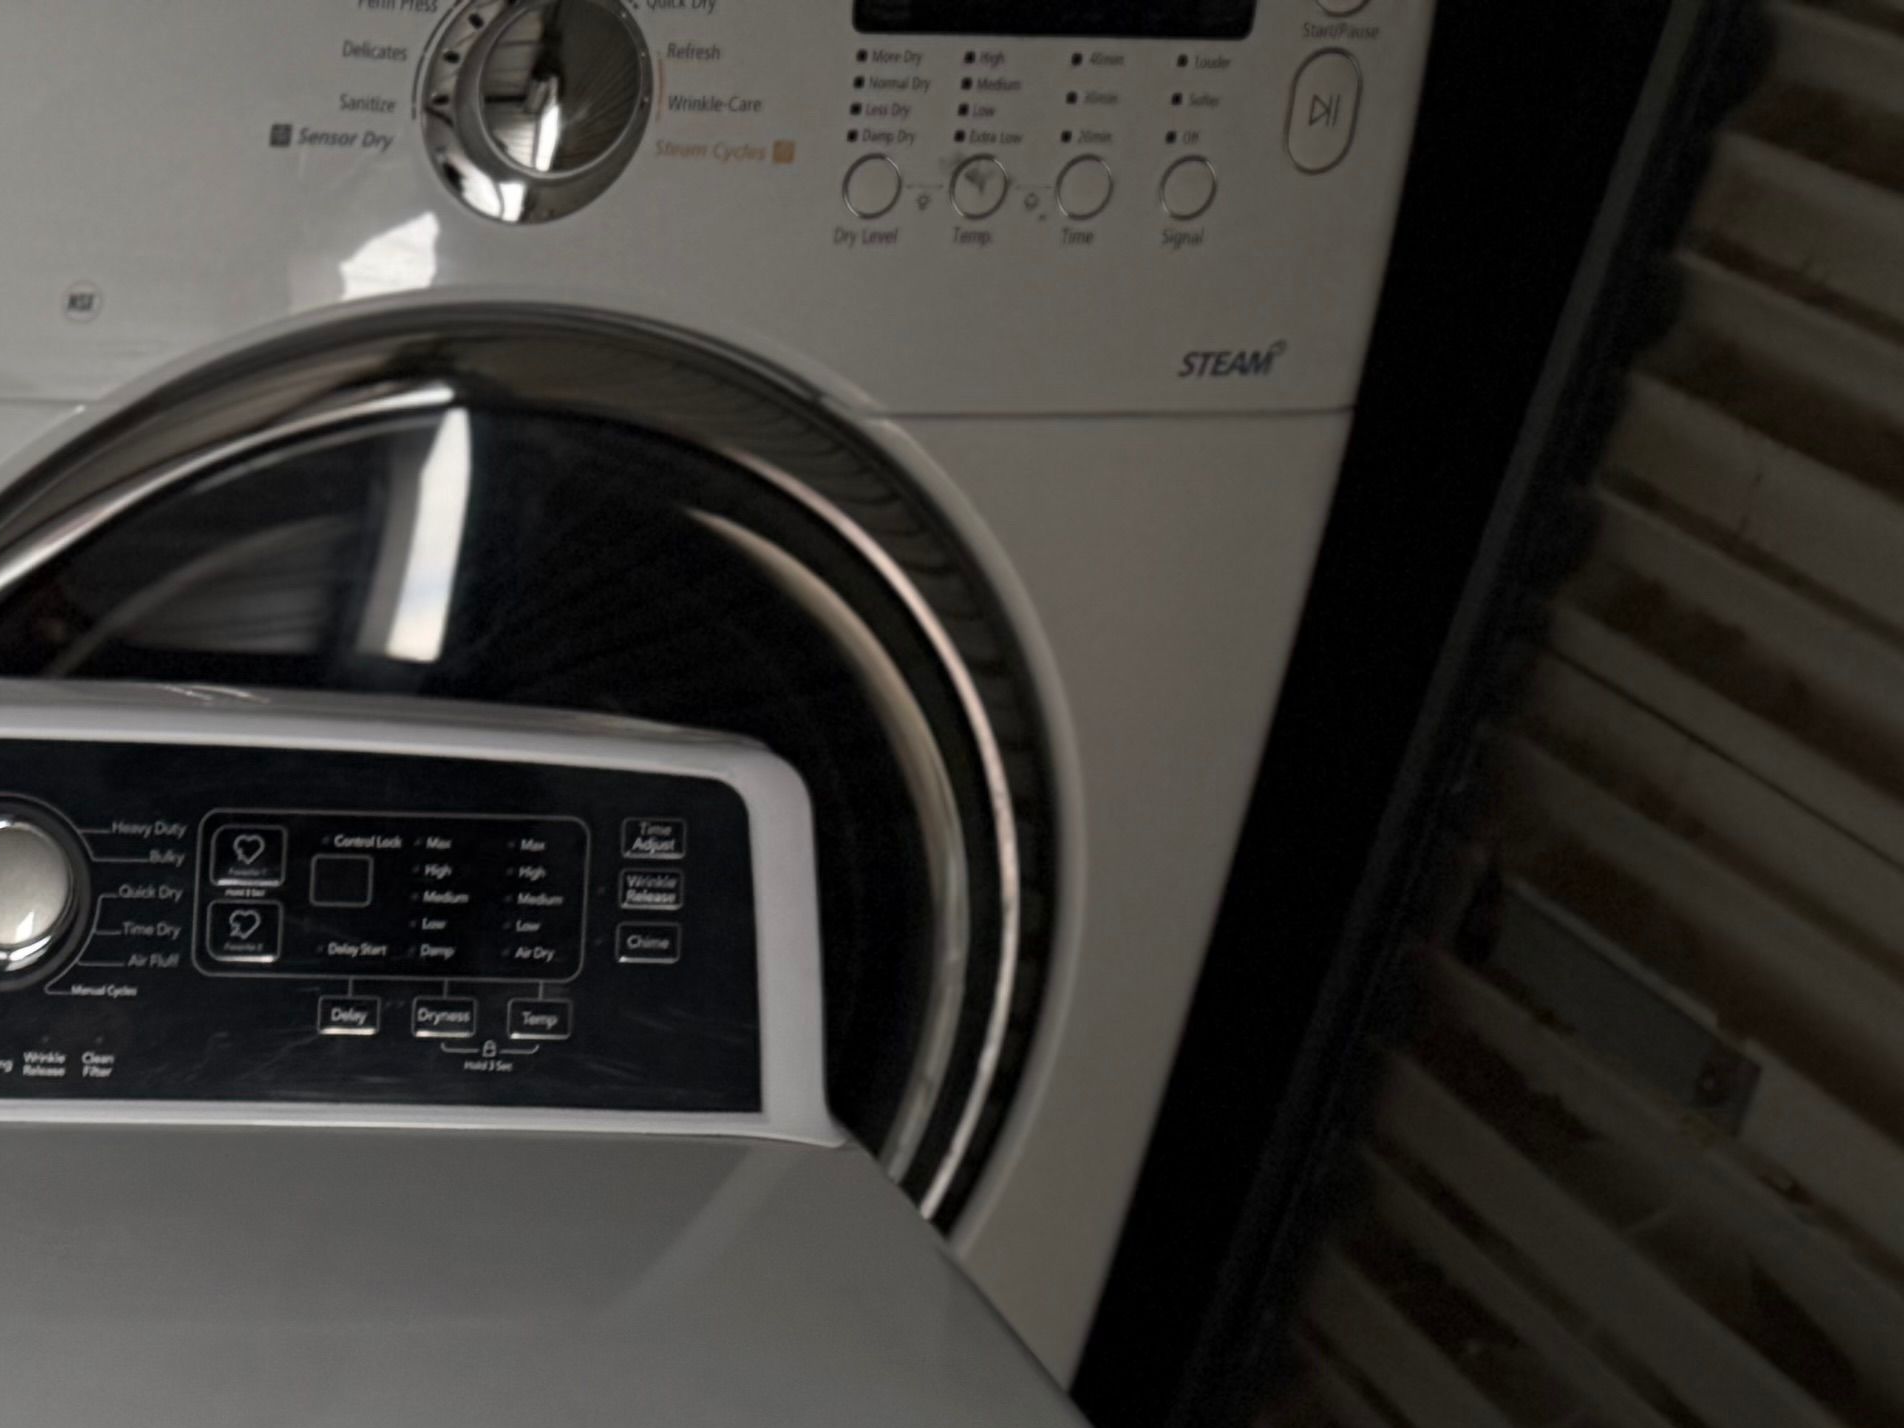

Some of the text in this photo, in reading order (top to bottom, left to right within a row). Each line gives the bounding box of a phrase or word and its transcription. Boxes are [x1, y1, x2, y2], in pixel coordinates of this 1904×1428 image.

[1302, 22, 1380, 40] Start/Pause
[342, 40, 407, 61] Delicates
[666, 43, 721, 61] Refresh
[871, 50, 924, 66] More Dry
[979, 52, 1005, 67] High
[1195, 54, 1231, 70] Louder
[869, 77, 931, 93] Normal Dry
[976, 79, 1021, 91] Medium
[340, 94, 395, 113] Sanitize
[667, 95, 763, 113] Wrinkle-Care
[865, 104, 911, 119] Less Dry
[972, 105, 995, 118] Low
[298, 127, 394, 152] Sensor Dry
[862, 130, 916, 146] Damp Dry
[969, 131, 1024, 144] Extra Low
[1183, 130, 1200, 144] Off
[656, 140, 768, 162] Steam Cycles
[833, 228, 898, 247] Dry Level
[1062, 228, 1095, 246] Time
[1161, 228, 1204, 249] Signal
[1177, 350, 1275, 378] STEAM
[112, 821, 187, 839] Heavy Duty
[639, 821, 672, 836] Time
[334, 835, 402, 849] Control Lock
[426, 837, 452, 850] Max
[520, 838, 545, 851] Max
[632, 837, 676, 853] Adjust
[149, 850, 185, 867] Bulky
[424, 864, 452, 880] High
[518, 866, 546, 882] High
[626, 875, 677, 888] Wrinkle
[118, 884, 184, 903] Quick Dry
[422, 891, 469, 903] Medium
[517, 893, 563, 905] Medium
[625, 889, 676, 902] Release
[121, 921, 182, 940] Time Dry
[421, 918, 447, 930] Low
[515, 920, 540, 932] Low
[626, 934, 670, 949] Chime
[327, 943, 387, 958] Delay Start
[420, 944, 455, 959] Damp
[514, 947, 555, 963] Air Dry
[127, 954, 180, 968] Air Fluff
[71, 984, 137, 998] Manual Cycles
[330, 1007, 368, 1025] Delay
[417, 1007, 470, 1025] Dryness
[521, 1011, 558, 1029] Temp
[23, 1051, 66, 1064] Wrinkle
[81, 1051, 114, 1064] Clean
[23, 1064, 66, 1077] Release
[82, 1065, 112, 1077] Filter
[464, 1060, 487, 1071] Hold
